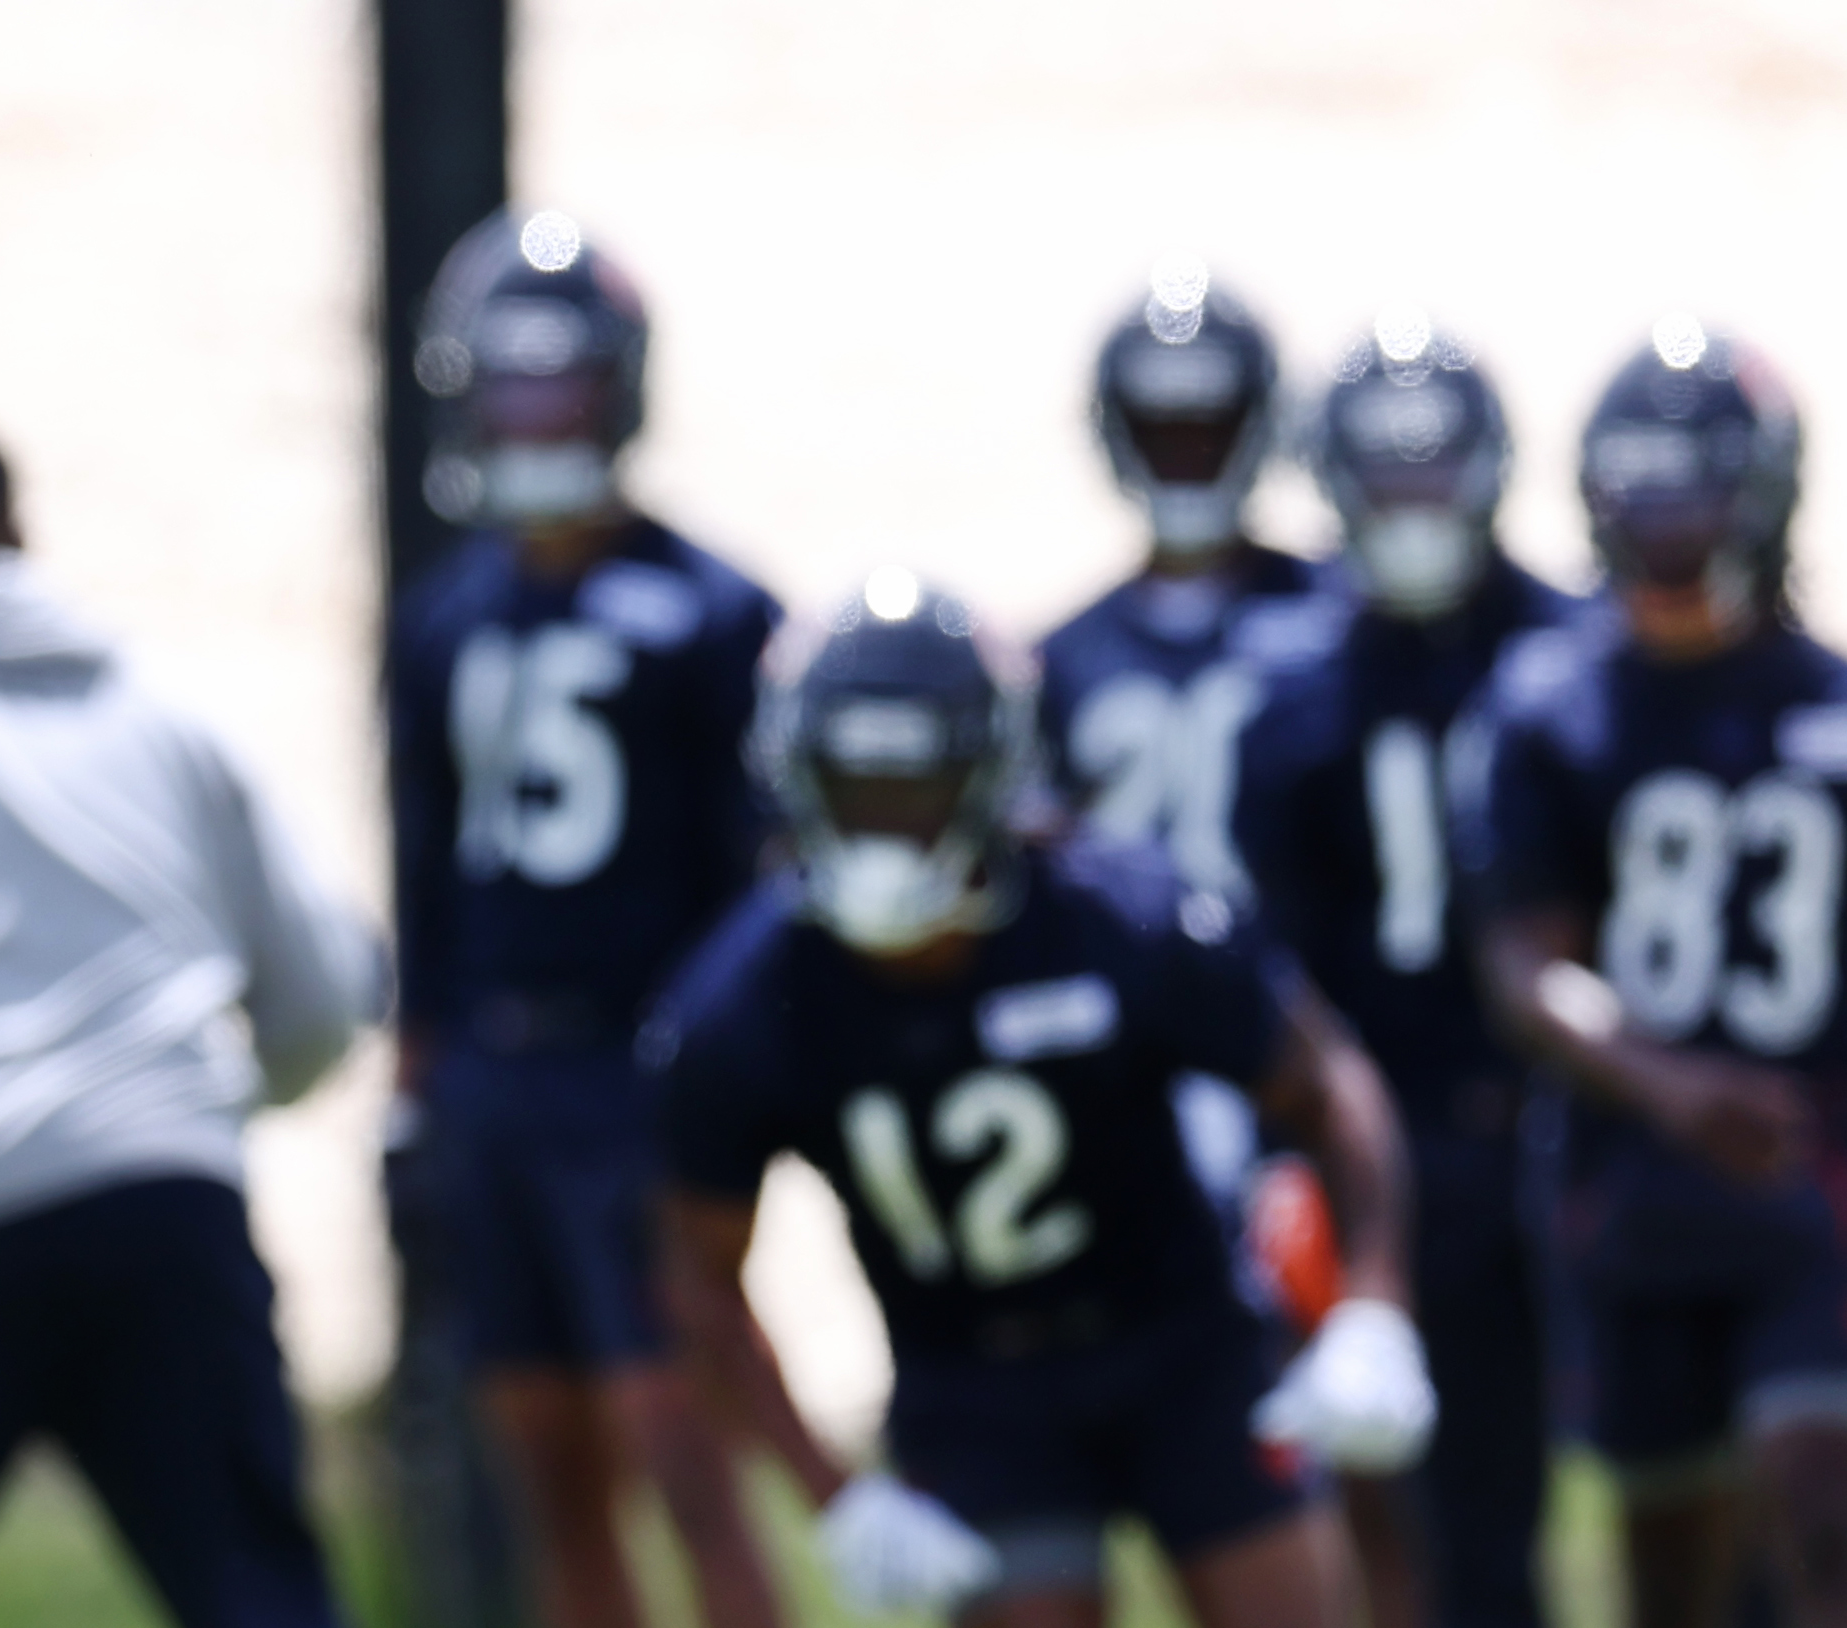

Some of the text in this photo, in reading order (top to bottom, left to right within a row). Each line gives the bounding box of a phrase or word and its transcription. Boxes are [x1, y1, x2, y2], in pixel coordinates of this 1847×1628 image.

[450, 628, 627, 884] 15
[1603, 770, 1843, 1052] 83
[841, 1072, 1093, 1282] 12
